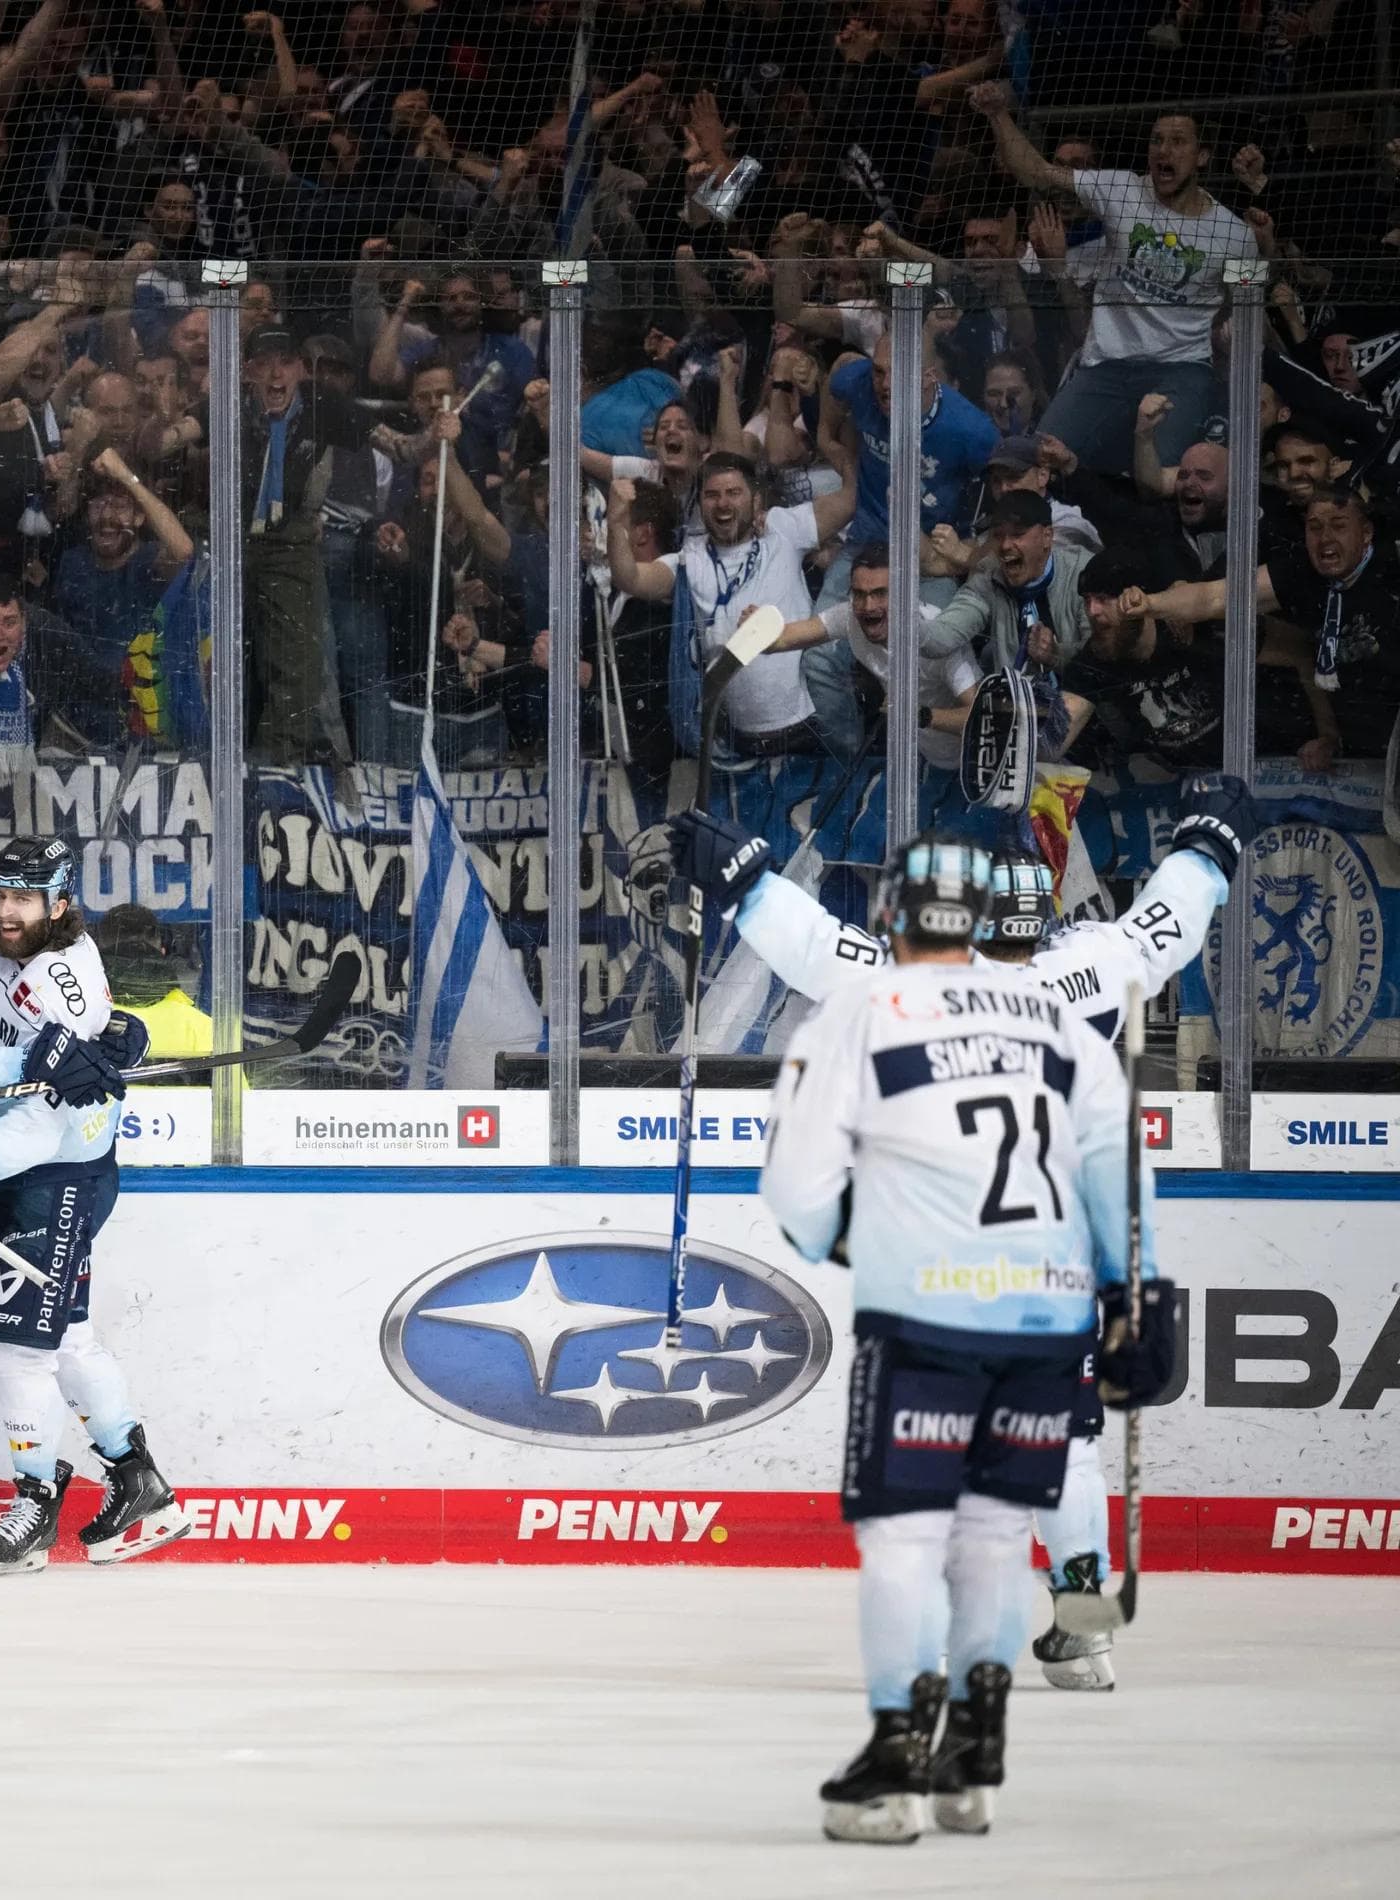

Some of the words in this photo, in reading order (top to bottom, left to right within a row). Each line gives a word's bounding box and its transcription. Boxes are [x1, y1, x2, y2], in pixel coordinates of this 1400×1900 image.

[295, 1115, 450, 1139] heinemann
[1287, 1120, 1389, 1146] SMILE
[295, 1140, 364, 1150] Leidenschaft
[366, 1140, 380, 1150] ist
[416, 1140, 450, 1150] Strom
[955, 1092, 1064, 1228] 21
